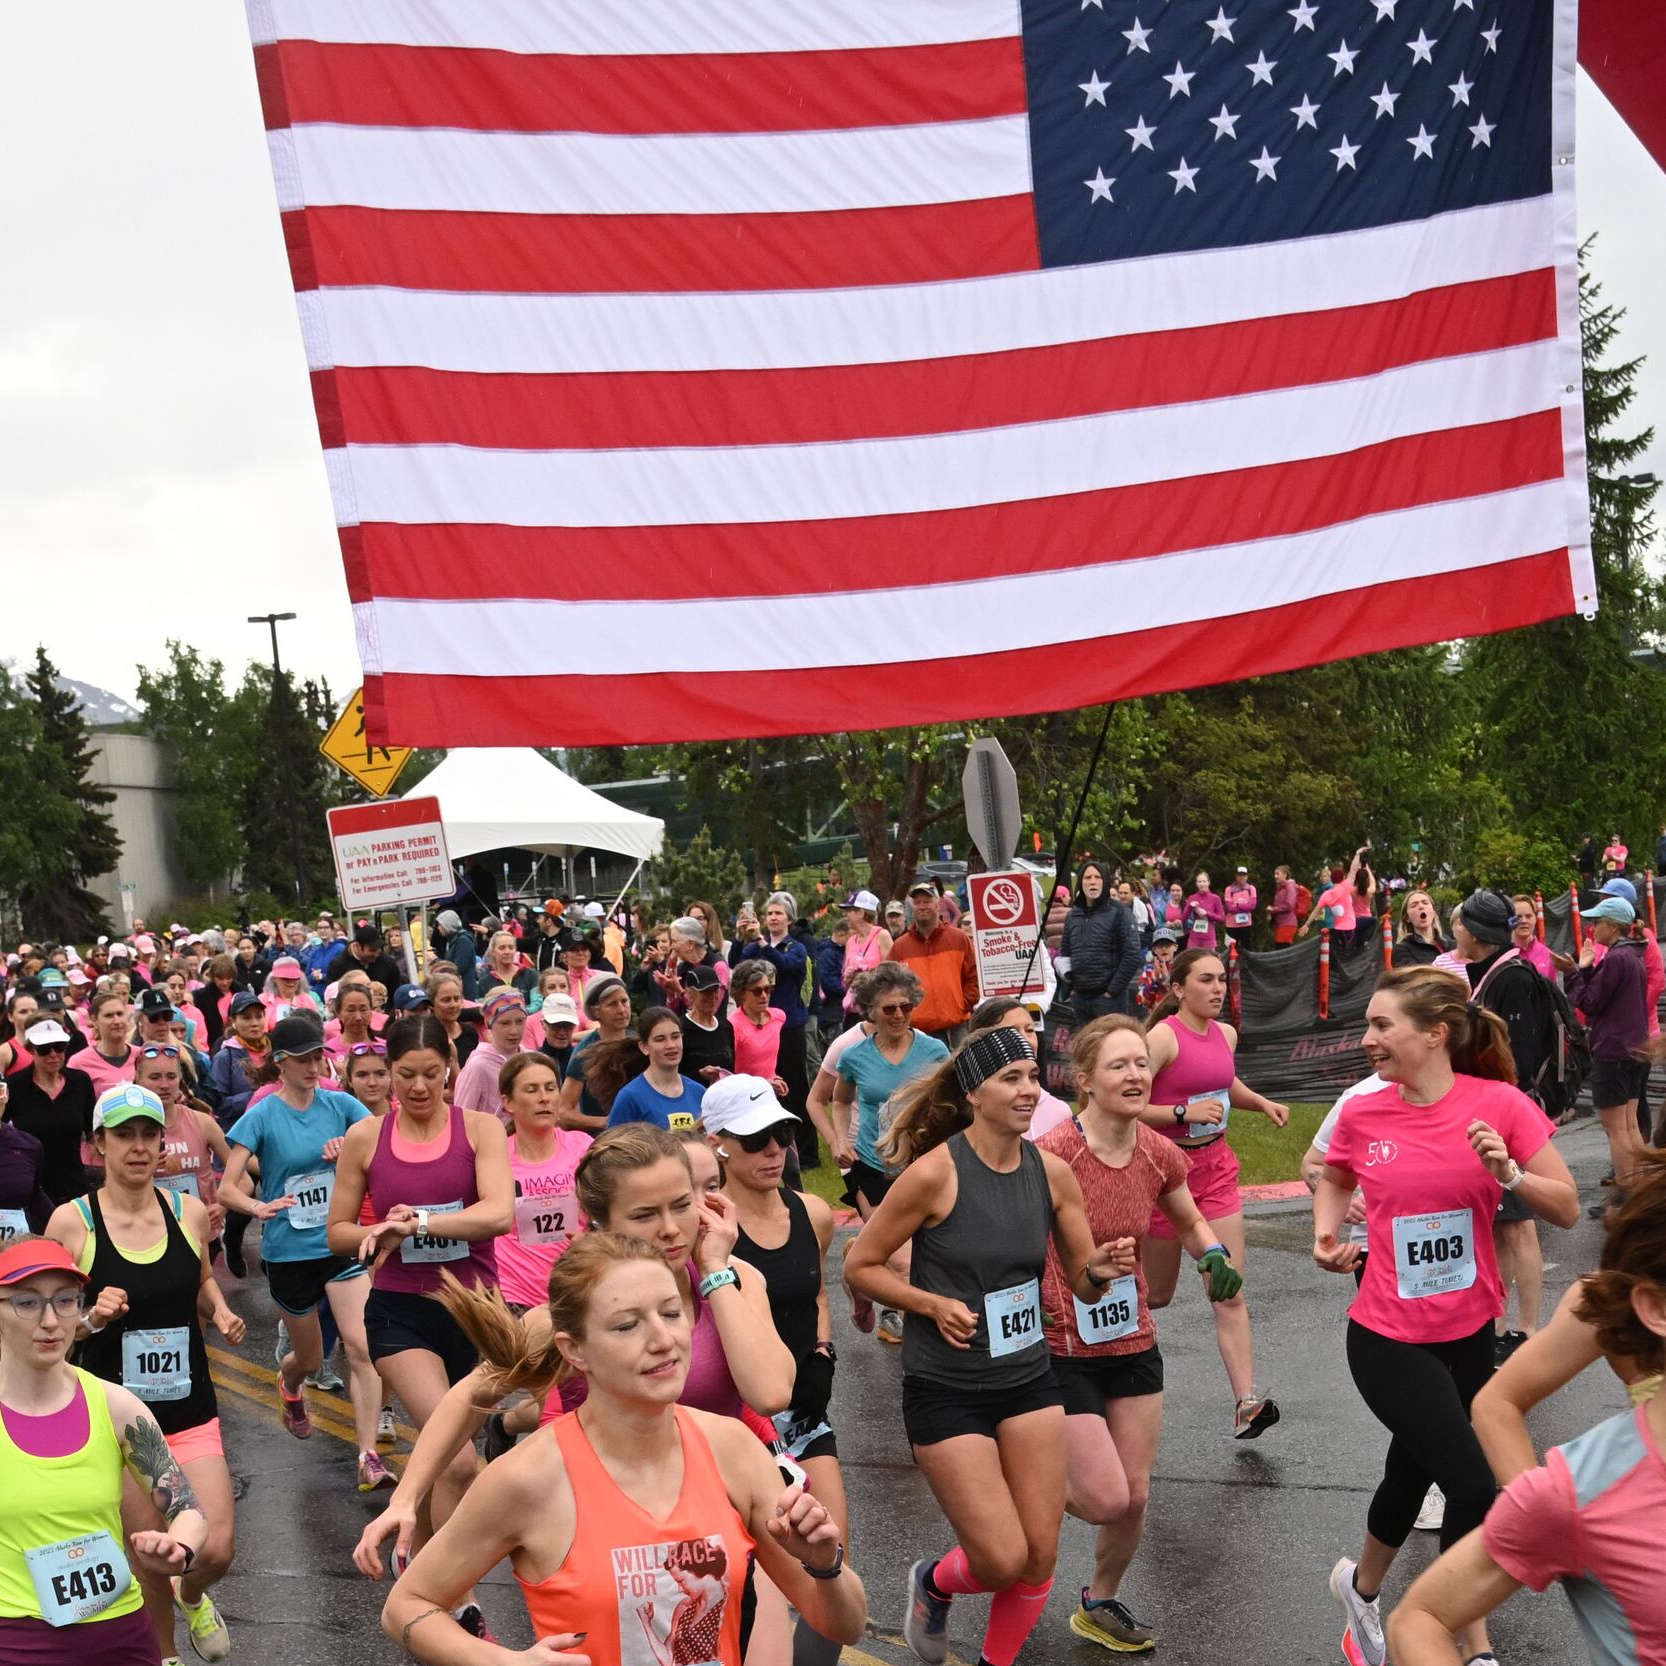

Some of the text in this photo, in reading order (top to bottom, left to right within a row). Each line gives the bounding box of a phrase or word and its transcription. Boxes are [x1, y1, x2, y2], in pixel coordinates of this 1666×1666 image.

[371, 839, 405, 853] PARKING
[408, 835, 437, 848] PERMIT
[346, 861, 354, 869] or
[357, 858, 372, 867] PAY
[379, 854, 399, 864] PARK
[402, 847, 440, 862] REQUIRED
[350, 877, 360, 885] For
[362, 872, 394, 883] Information
[396, 870, 408, 878] Call
[364, 881, 400, 893] Emergencies
[401, 879, 413, 887] Call
[981, 940, 1036, 958] Tobacco-Free
[984, 932, 1021, 948] Smoke &
[1015, 949, 1034, 960] UAA
[297, 1186, 328, 1208] 1147
[533, 1212, 565, 1234] 122
[1407, 1235, 1464, 1266] E403
[1001, 1305, 1036, 1339] E421
[1088, 1299, 1130, 1329] 1135
[136, 1350, 181, 1374] 1021
[613, 1538, 718, 1574] WILL RACE
[51, 1562, 116, 1606] E413
[618, 1572, 658, 1600] FOR
